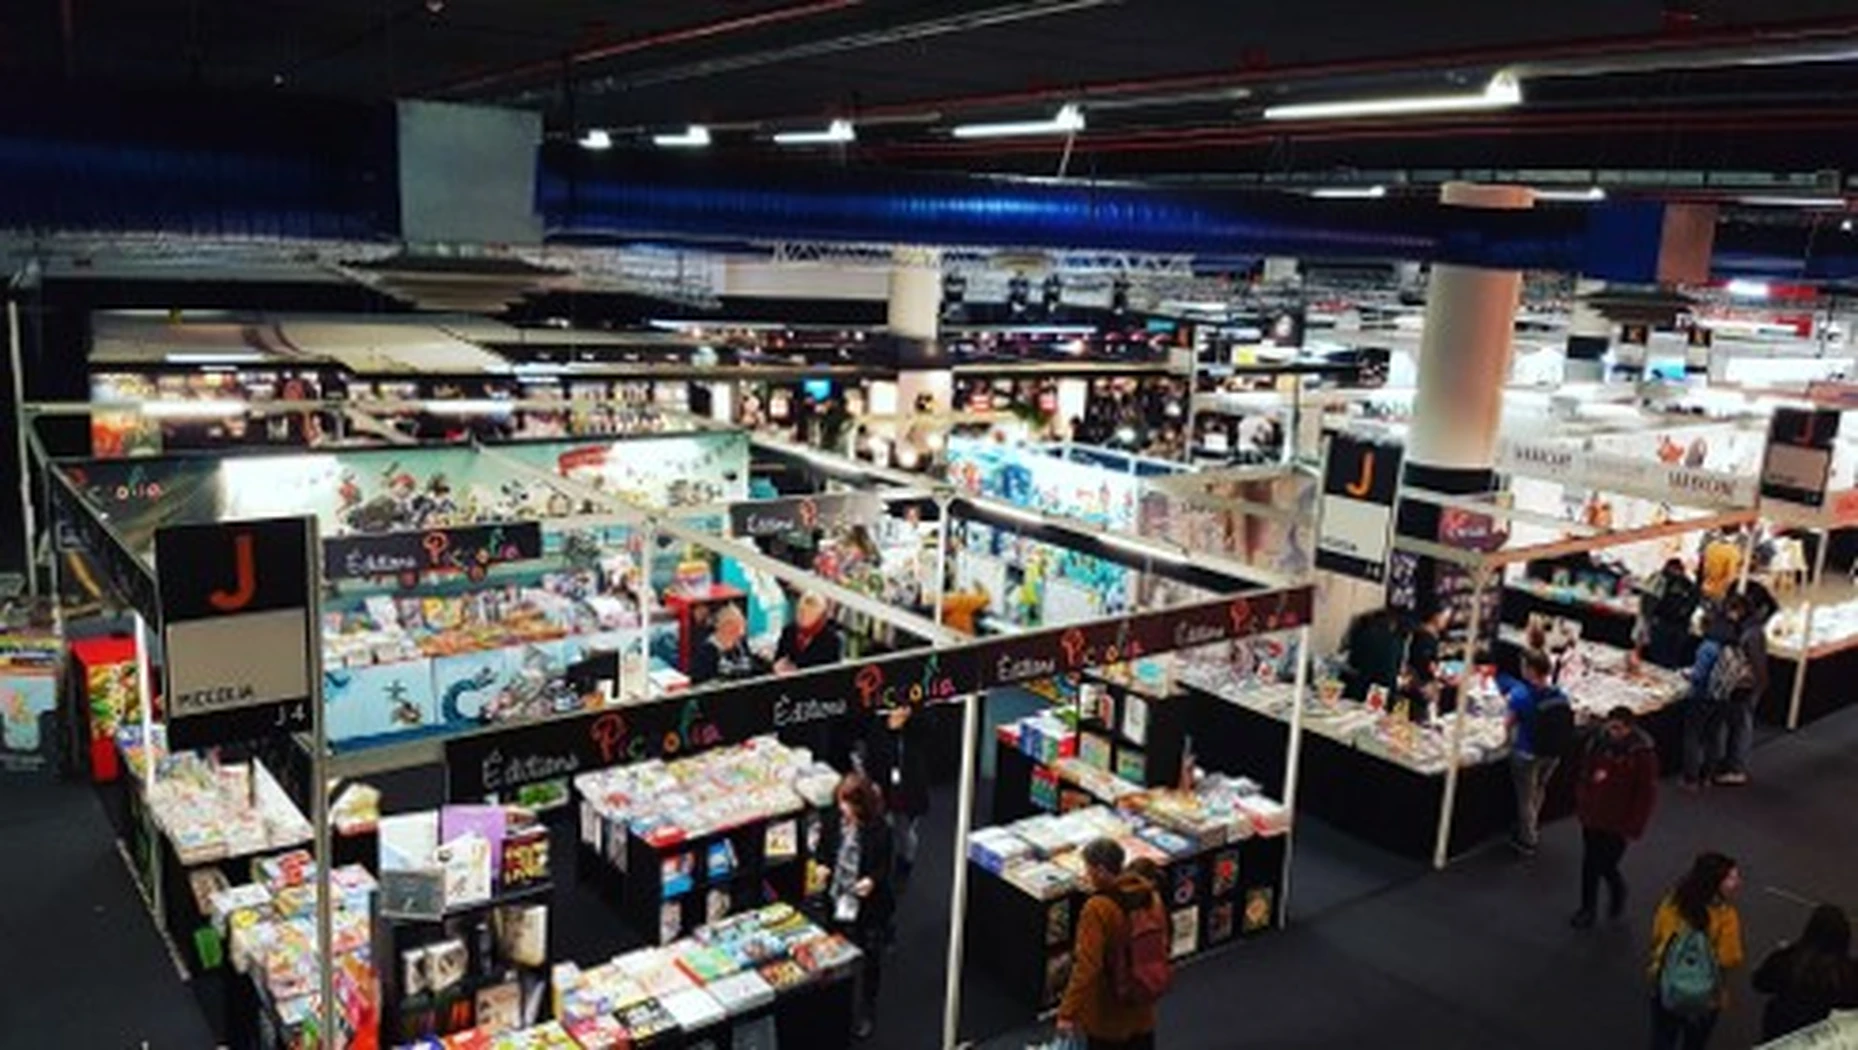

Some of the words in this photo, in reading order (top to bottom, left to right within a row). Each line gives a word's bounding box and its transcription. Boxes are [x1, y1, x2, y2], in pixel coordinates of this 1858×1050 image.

[1345, 450, 1376, 497] J
[209, 535, 257, 612] J
[481, 749, 580, 790] Éditions
[590, 699, 723, 764] Picolia
